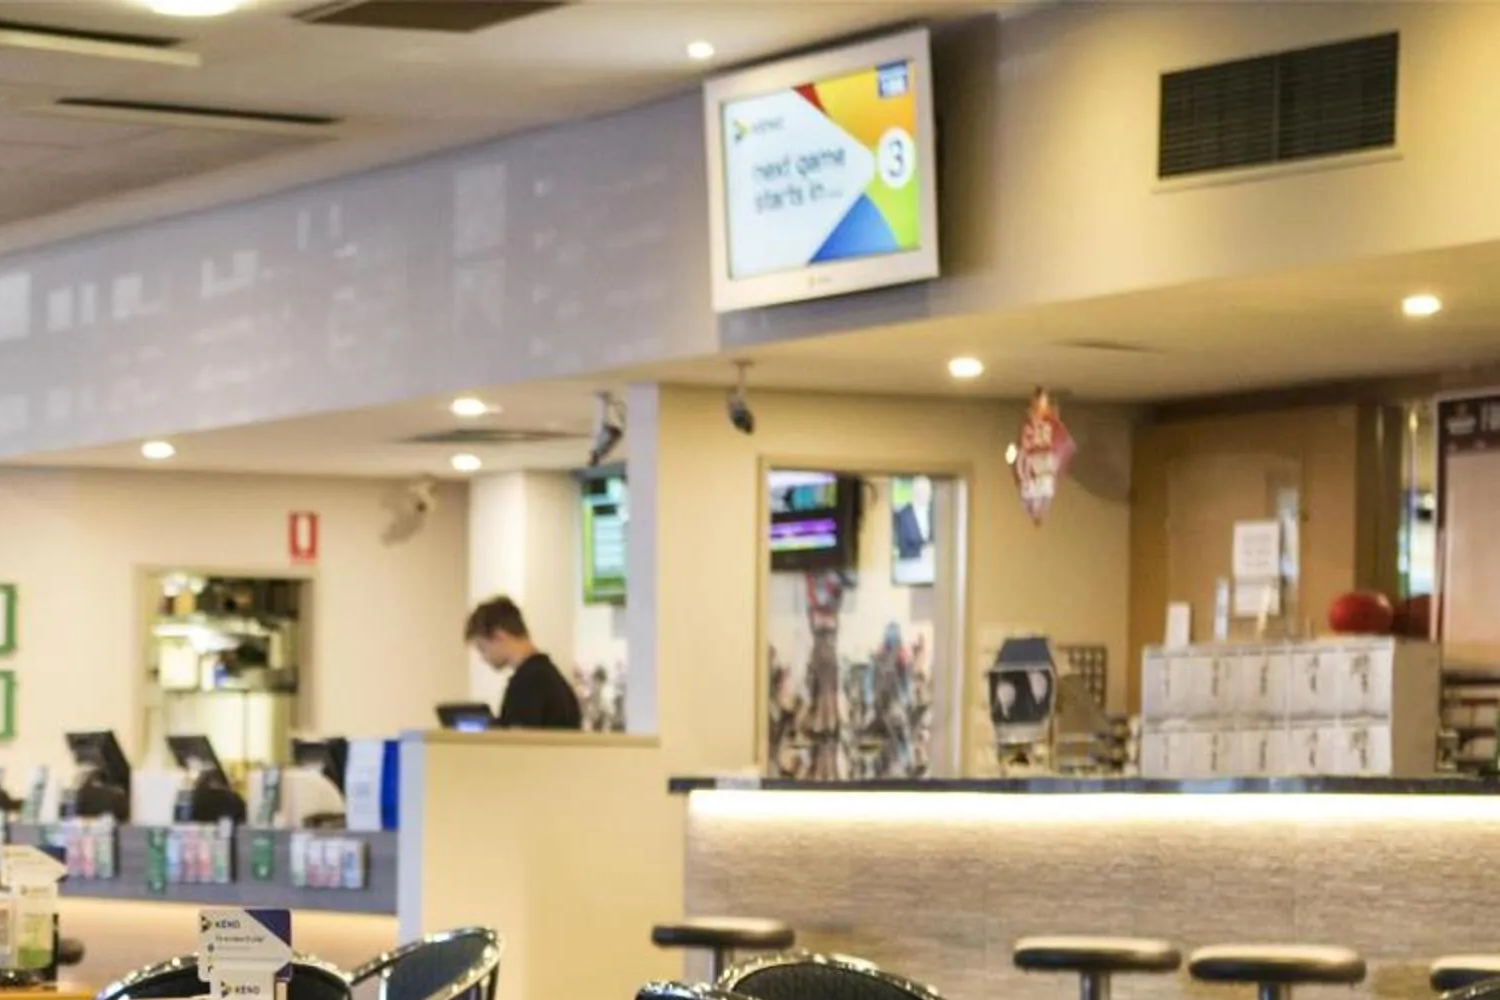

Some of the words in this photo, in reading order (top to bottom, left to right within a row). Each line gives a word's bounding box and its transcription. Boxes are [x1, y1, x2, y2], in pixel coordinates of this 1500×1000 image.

[888, 139, 905, 178] 3
[215, 919, 241, 929] KENO
[235, 985, 261, 995] KENO
